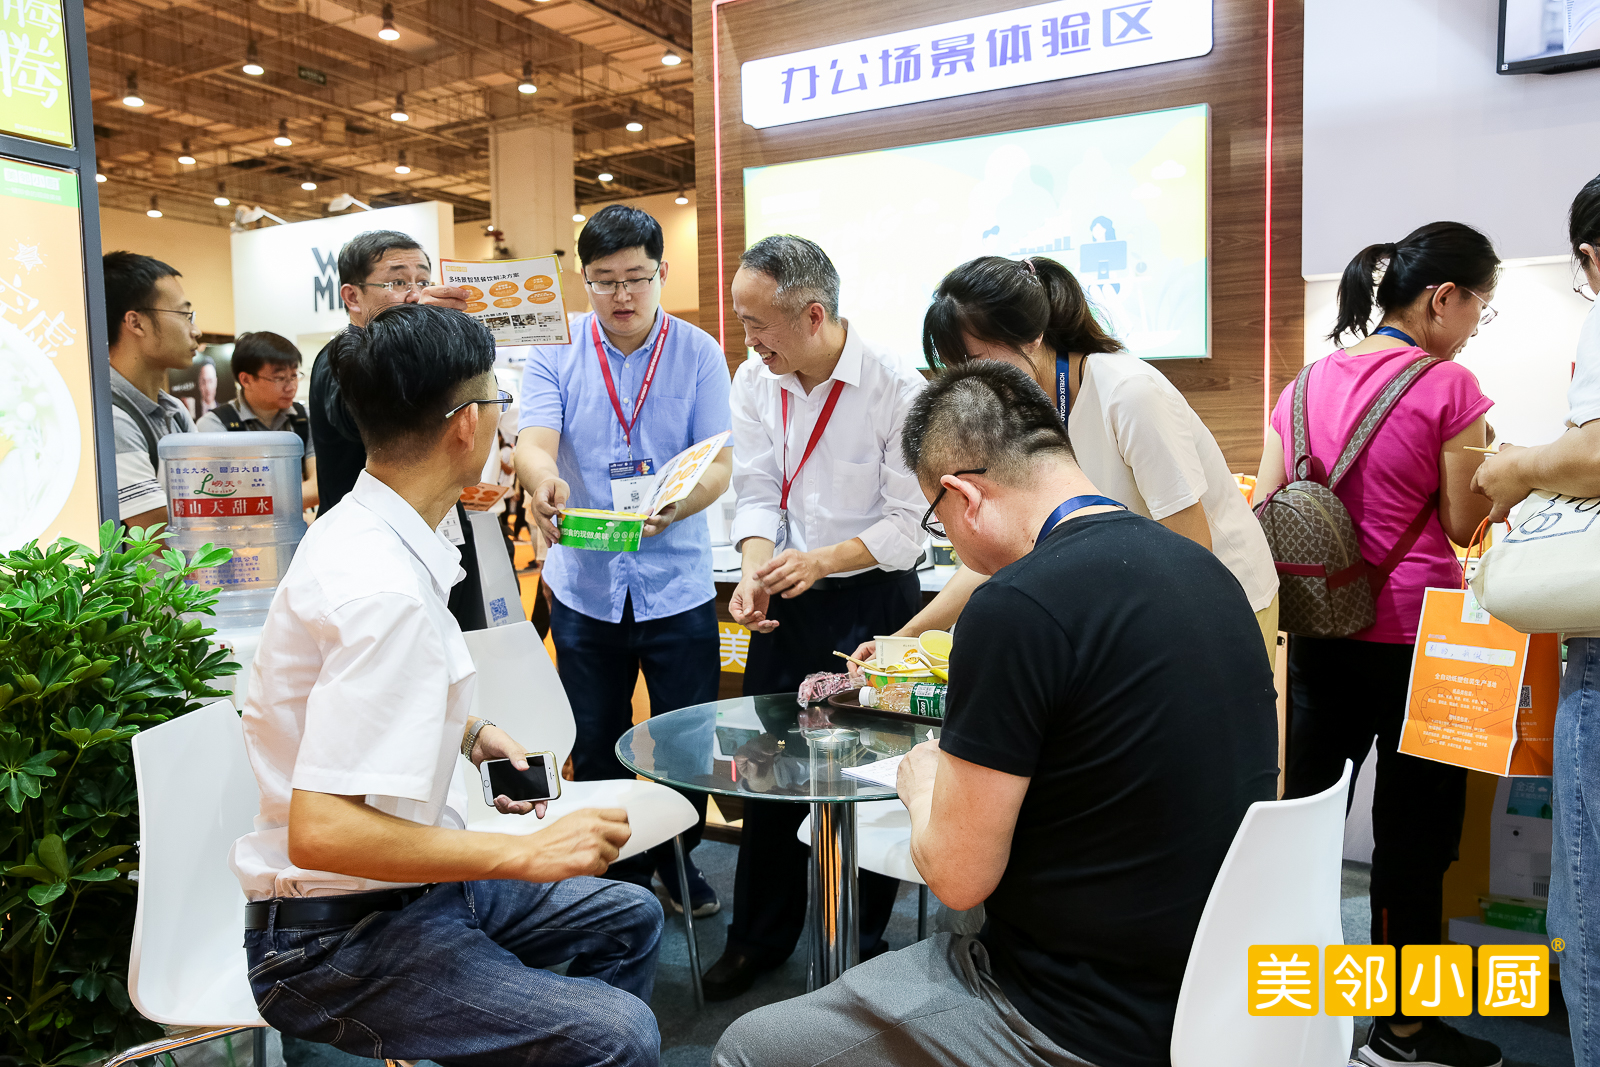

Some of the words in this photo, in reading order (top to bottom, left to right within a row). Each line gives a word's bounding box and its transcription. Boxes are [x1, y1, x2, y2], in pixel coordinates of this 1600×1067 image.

[781, 1, 1153, 104] 办公场景体验区
[449, 272, 520, 283] 多场景智慧餐饮解决方案
[219, 465, 270, 474] 回归大自然
[175, 498, 270, 516] 崂山天甜水
